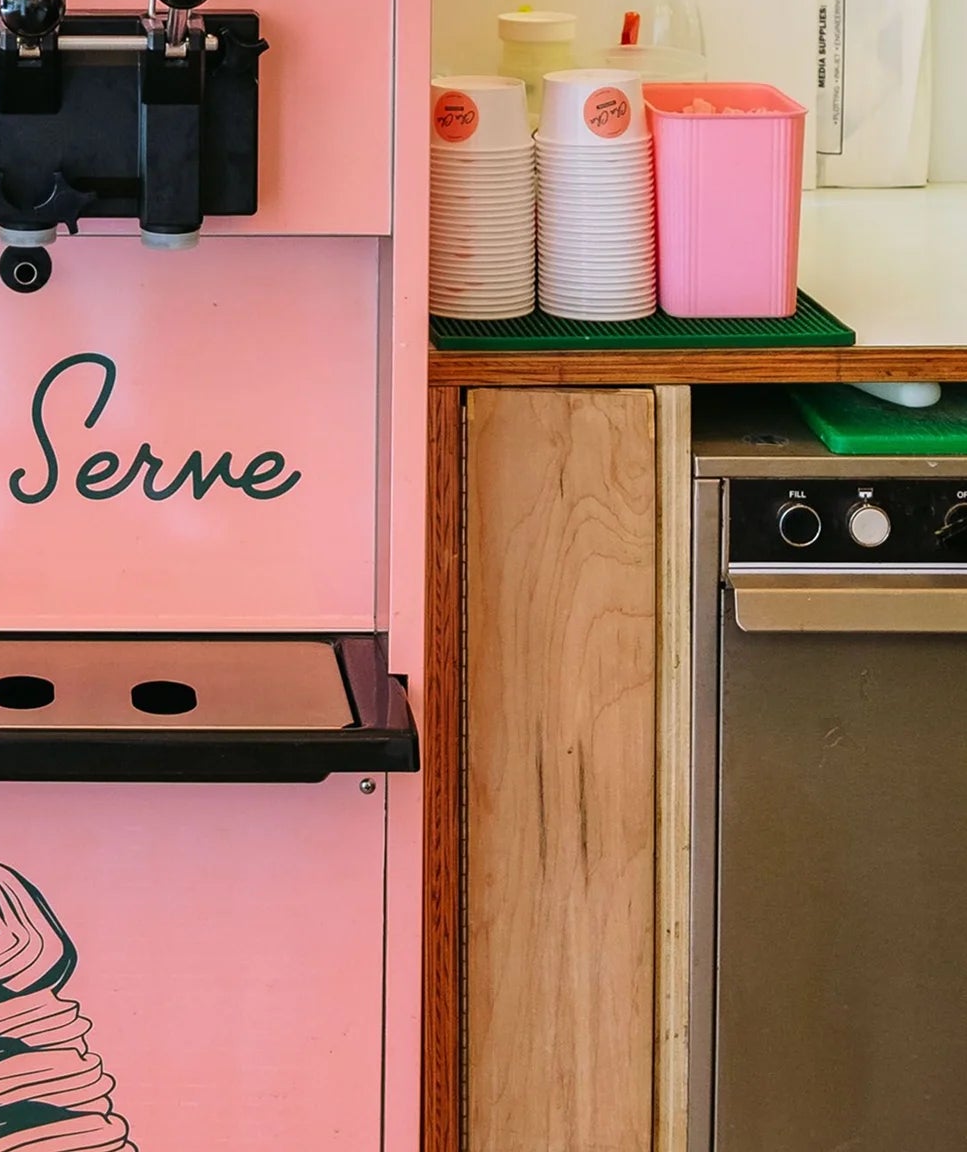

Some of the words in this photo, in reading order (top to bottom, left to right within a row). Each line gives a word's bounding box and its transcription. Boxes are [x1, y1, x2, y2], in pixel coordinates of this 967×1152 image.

[818, 57, 826, 88] MEDIA
[9, 352, 303, 505] Serve
[789, 490, 807, 498] FILL
